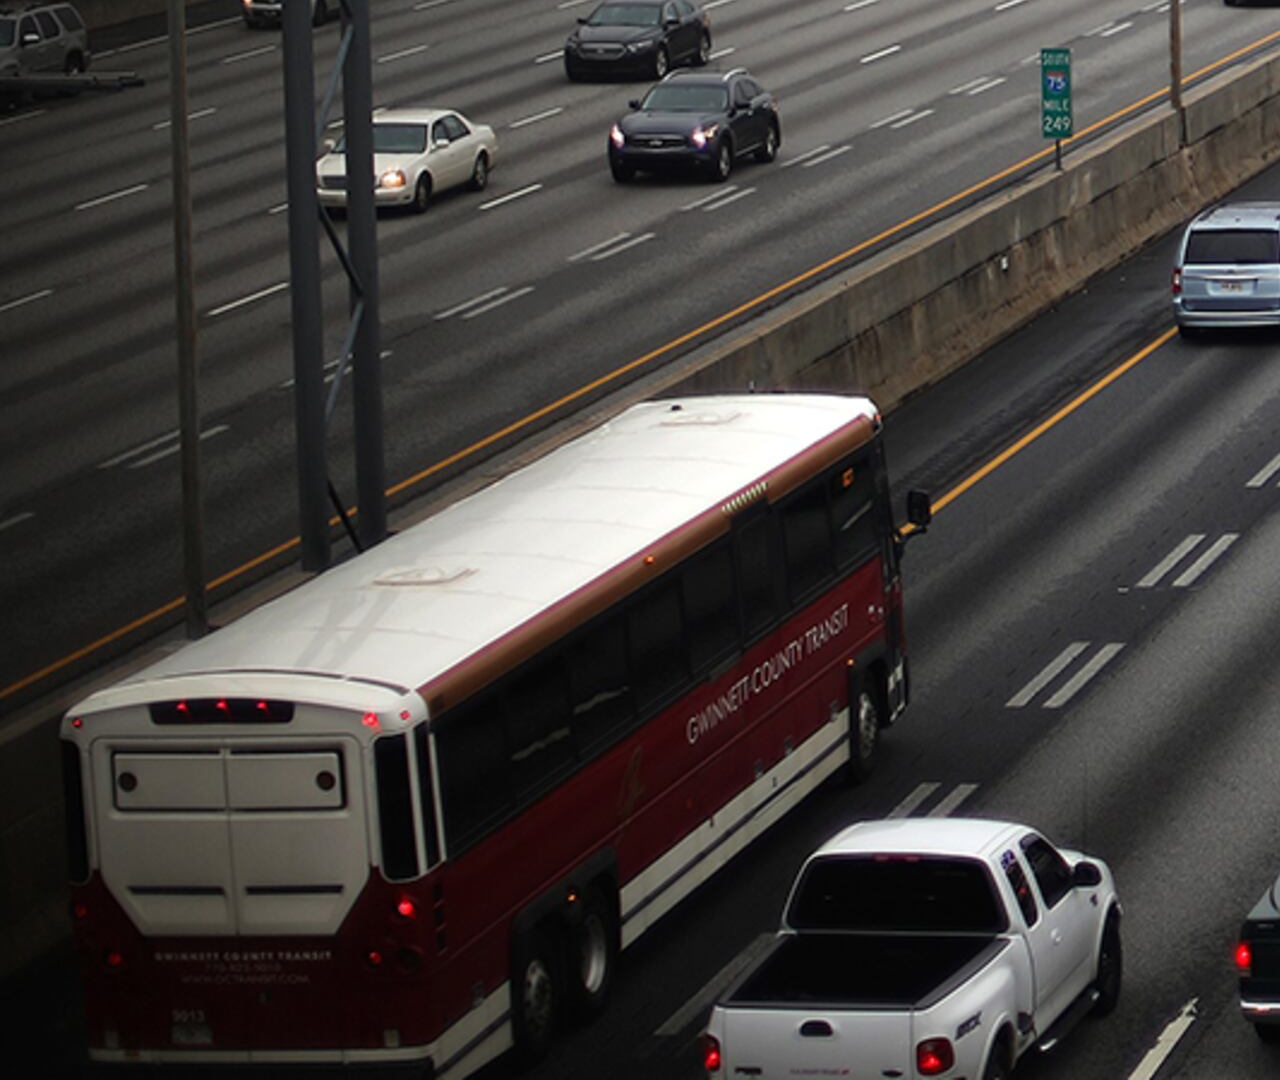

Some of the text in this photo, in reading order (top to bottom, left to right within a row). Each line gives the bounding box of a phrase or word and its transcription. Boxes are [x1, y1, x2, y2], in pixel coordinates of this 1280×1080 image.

[1048, 75, 1065, 90] 75
[1044, 115, 1071, 133] 249
[686, 603, 849, 744] GWINNETT COUNTY TRANSIT
[155, 950, 332, 961] GWINNETT COUNTY TRANSIT
